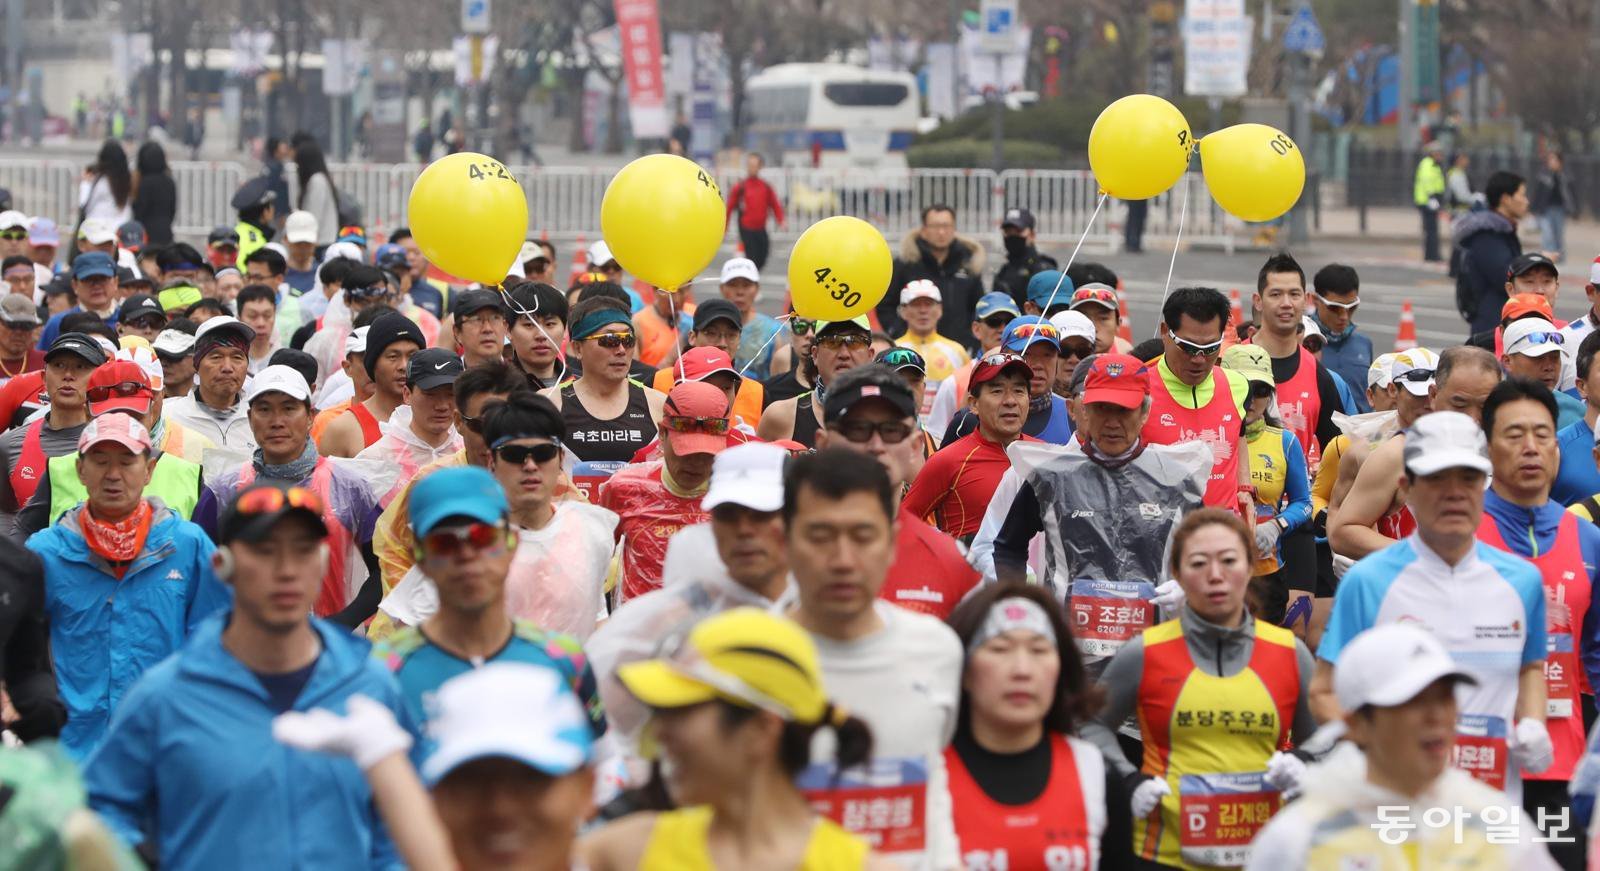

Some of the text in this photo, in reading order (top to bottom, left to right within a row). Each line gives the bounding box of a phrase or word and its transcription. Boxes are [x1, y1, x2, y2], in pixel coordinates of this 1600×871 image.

[814, 267, 862, 308] 4:30
[572, 430, 642, 442] 속초마라톤
[1251, 471, 1273, 482] 라톤
[1076, 611, 1090, 626] D
[1099, 605, 1145, 625] 조효선
[1544, 660, 1563, 681] 순
[1189, 812, 1207, 833] D
